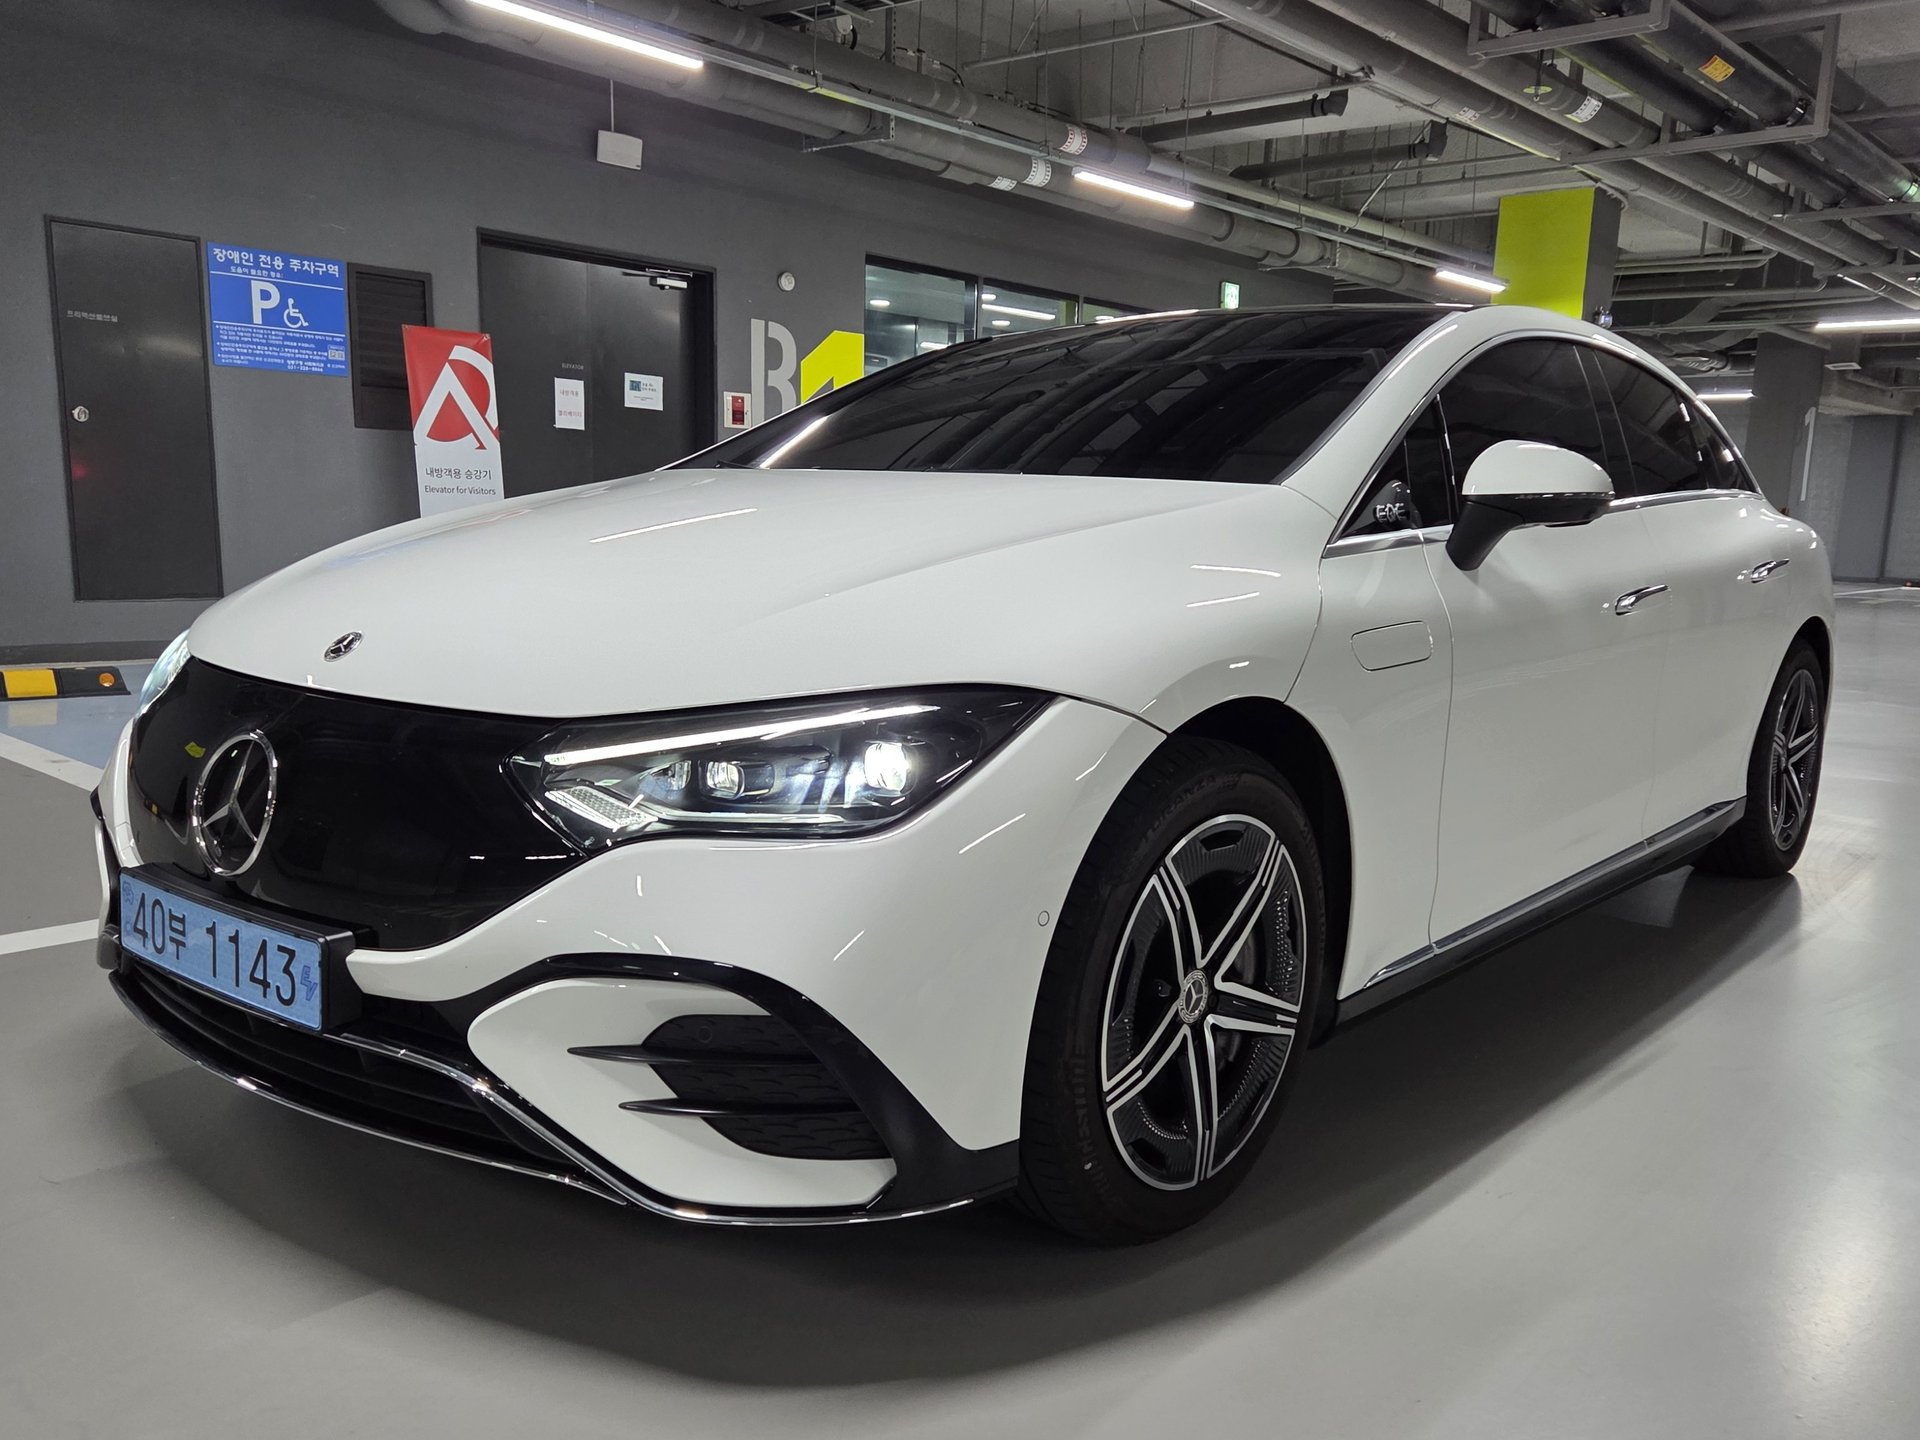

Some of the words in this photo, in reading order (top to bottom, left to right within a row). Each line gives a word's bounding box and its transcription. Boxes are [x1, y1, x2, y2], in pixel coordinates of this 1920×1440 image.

[213, 247, 254, 266] 장애인
[258, 254, 285, 271] 전용
[289, 258, 339, 278] 주차구역
[251, 279, 281, 325] P
[425, 466, 462, 480] 내방객용
[464, 469, 492, 480] 승강기
[424, 485, 455, 494] Elevator
[456, 486, 467, 494] for
[468, 486, 497, 496] Visitors
[133, 892, 187, 961] 40부
[205, 920, 297, 1007] 1143
